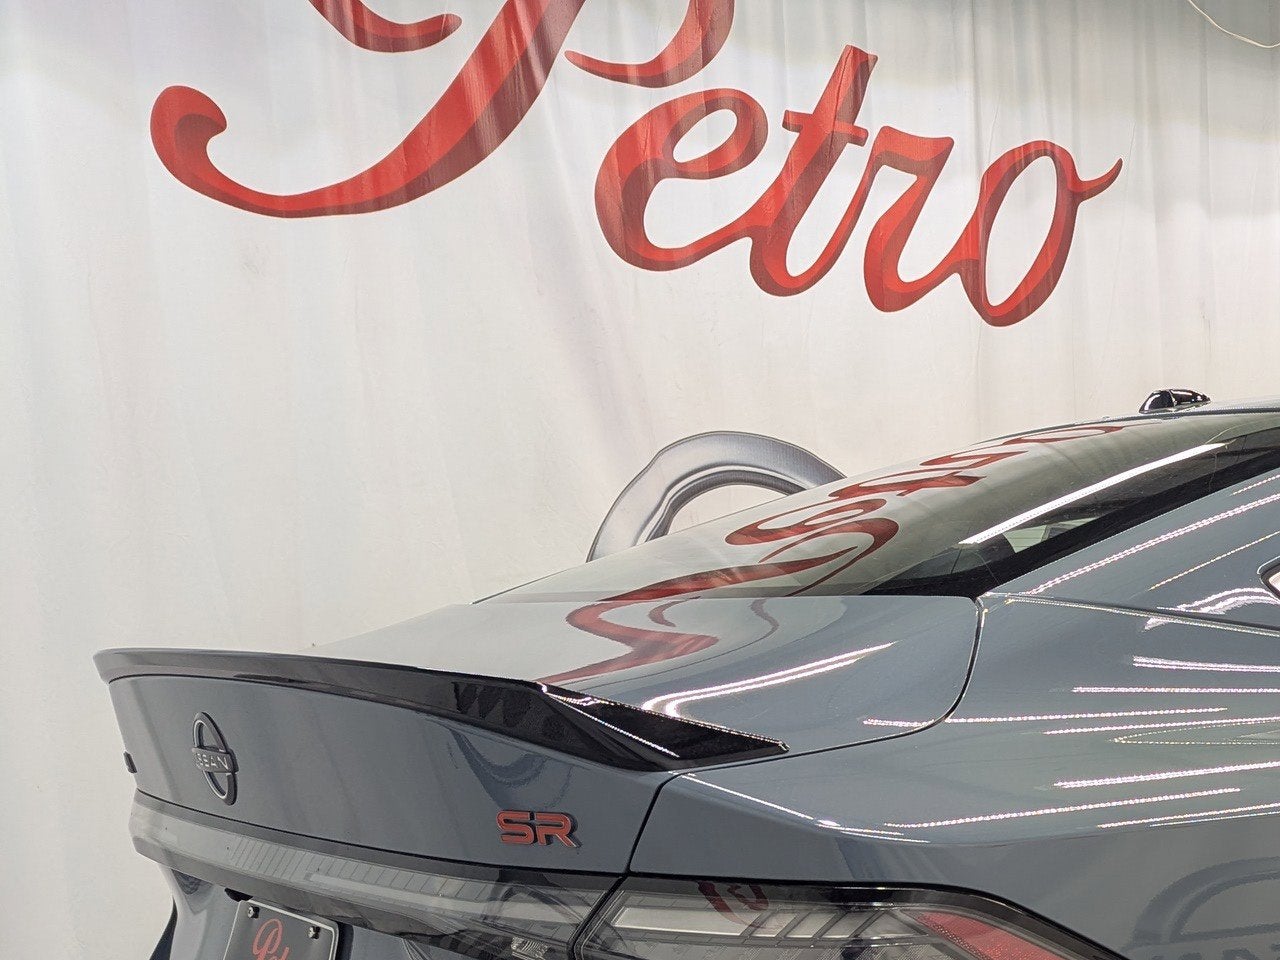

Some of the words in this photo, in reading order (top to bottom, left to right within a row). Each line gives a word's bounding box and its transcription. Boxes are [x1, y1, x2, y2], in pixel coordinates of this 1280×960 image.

[150, 0, 1122, 327] Petro
[196, 752, 229, 771] SSAN
[496, 810, 580, 847] SR
